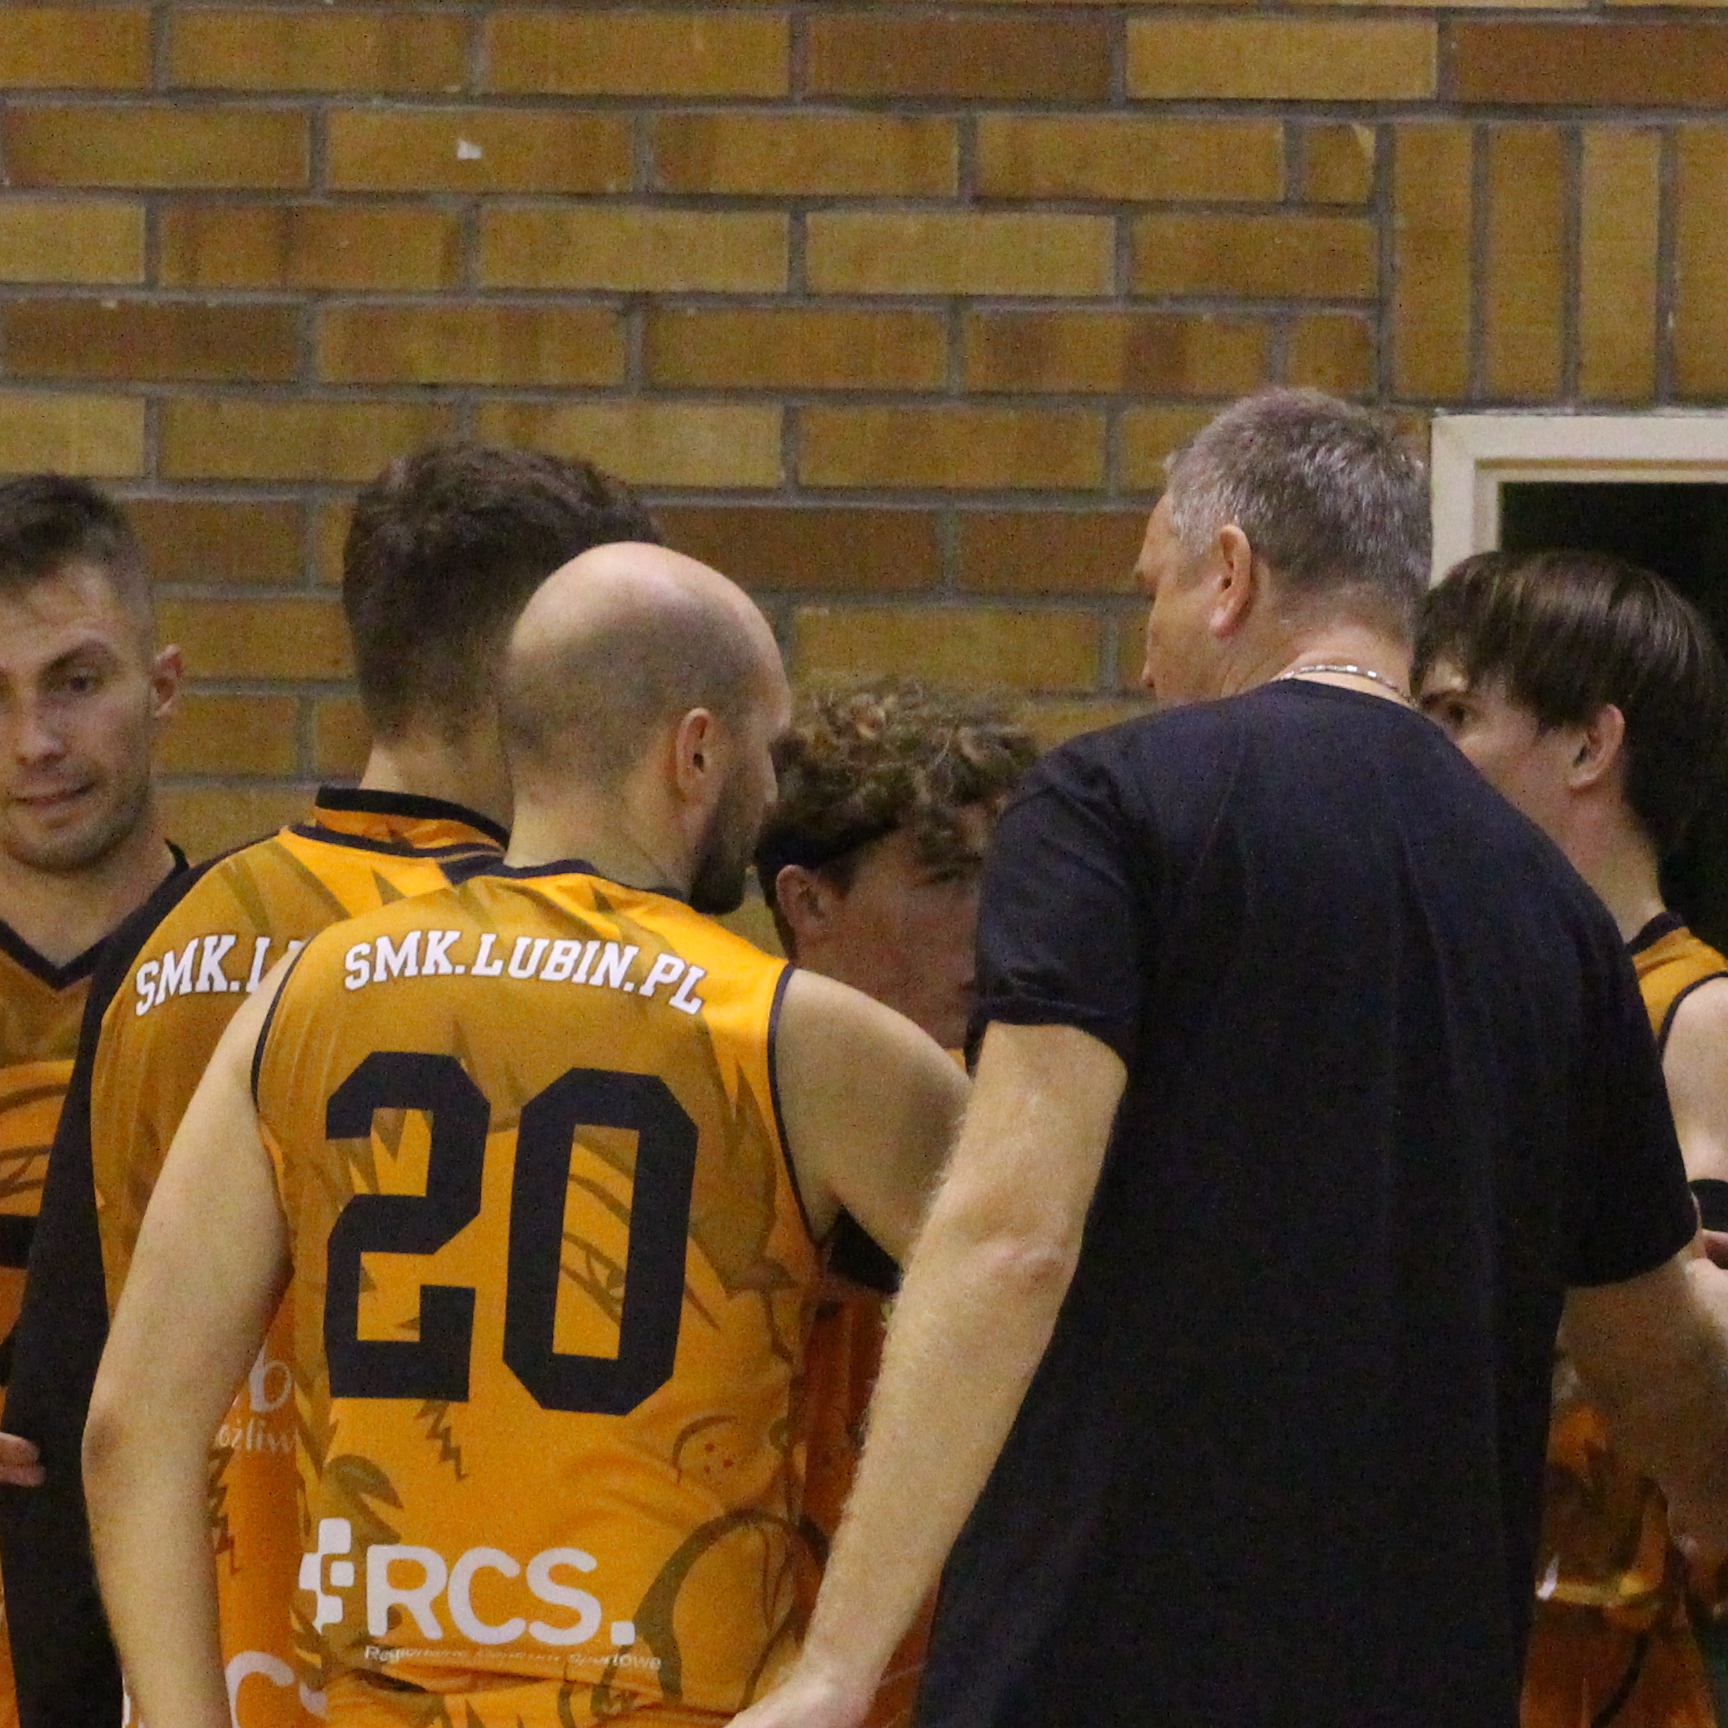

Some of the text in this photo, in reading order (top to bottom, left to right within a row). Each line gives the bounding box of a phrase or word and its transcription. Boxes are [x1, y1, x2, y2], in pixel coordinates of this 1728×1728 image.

[135, 934, 306, 1016] SMK.L
[344, 930, 706, 1015] SMK.LUBIN.PL
[323, 1050, 699, 1416] 20
